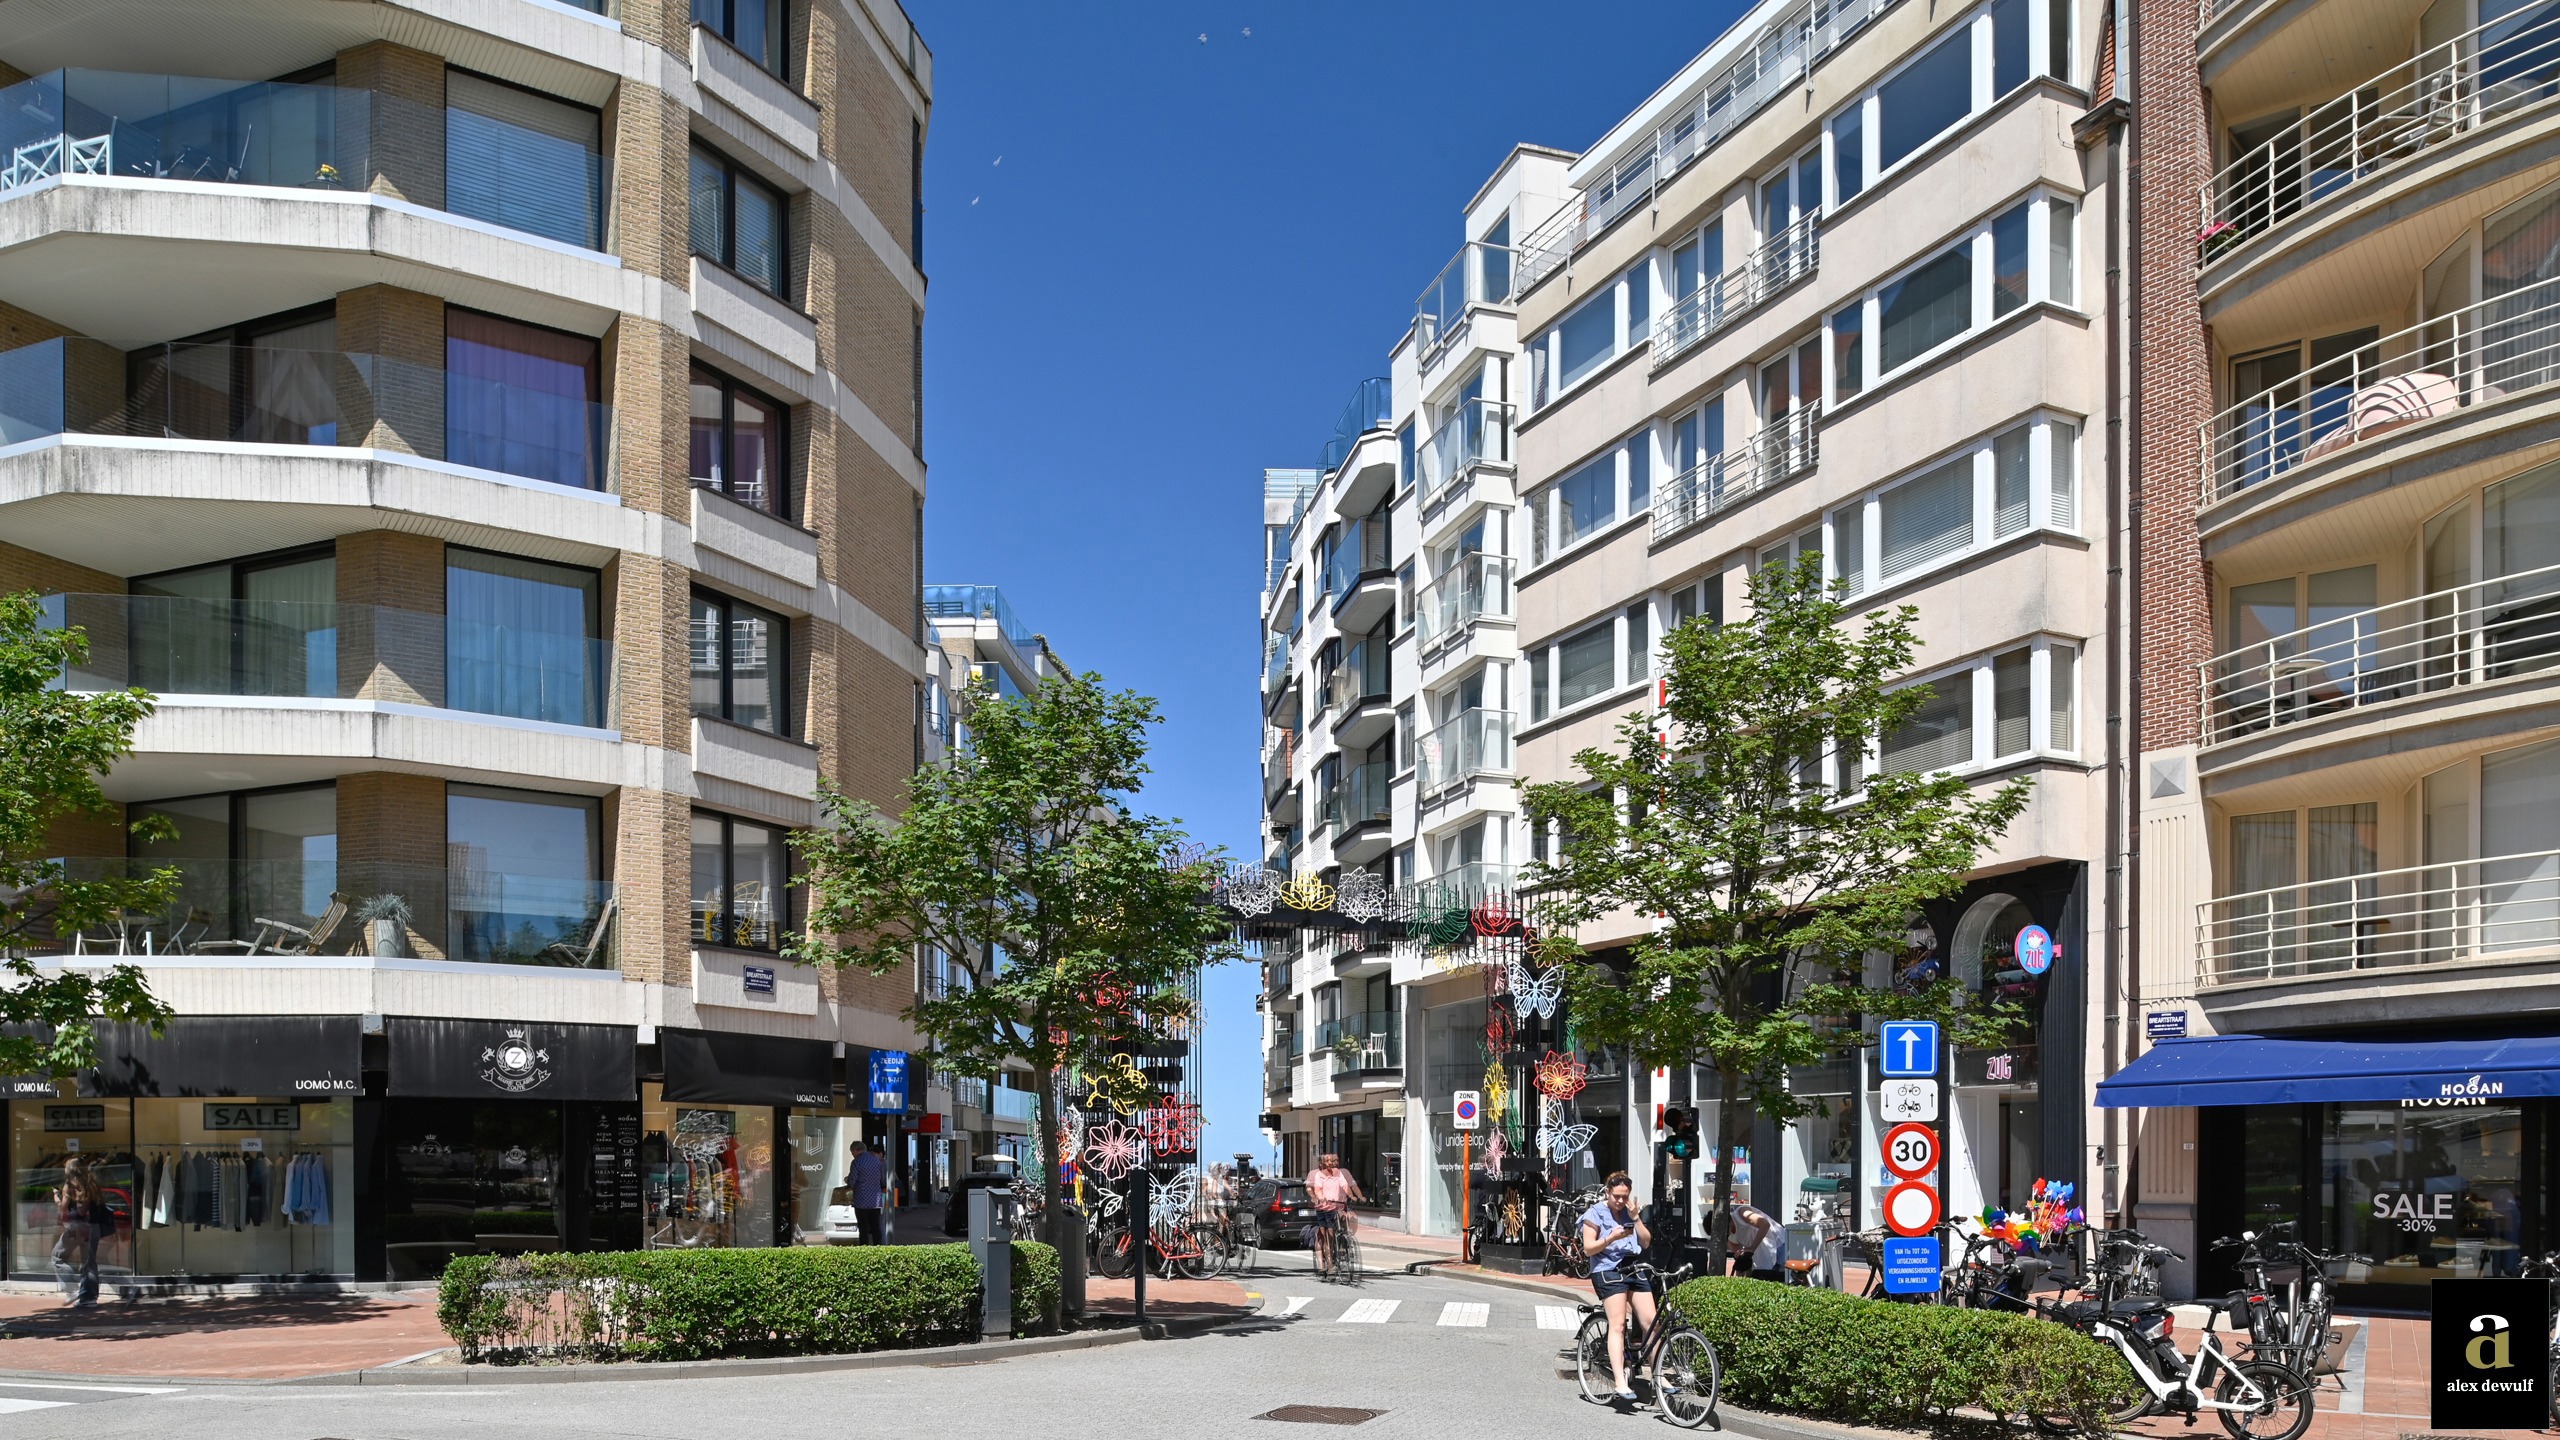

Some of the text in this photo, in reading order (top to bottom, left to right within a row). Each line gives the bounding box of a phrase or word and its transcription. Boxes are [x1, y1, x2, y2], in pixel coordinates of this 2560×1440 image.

[2148, 1016, 2184, 1024] BREARTSTRAAT
[880, 1057, 906, 1065] ZEEDIJK
[295, 1080, 357, 1090] UOMO M.C.
[880, 1076, 904, 1084] 719-747
[14, 1082, 52, 1093] UOMO M.C.
[2441, 1082, 2503, 1096] HOGAN
[796, 1094, 816, 1103] UOMO
[50, 1109, 98, 1128] SALE
[214, 1108, 290, 1126] SALE
[1445, 1132, 1484, 1150] unideelop
[1895, 1140, 1927, 1162] 30
[2373, 1193, 2453, 1219] SALE
[2397, 1219, 2436, 1232] -30%
[1911, 1247, 1920, 1255] TOT
[1896, 1257, 1928, 1265] UITGEZONDERD
